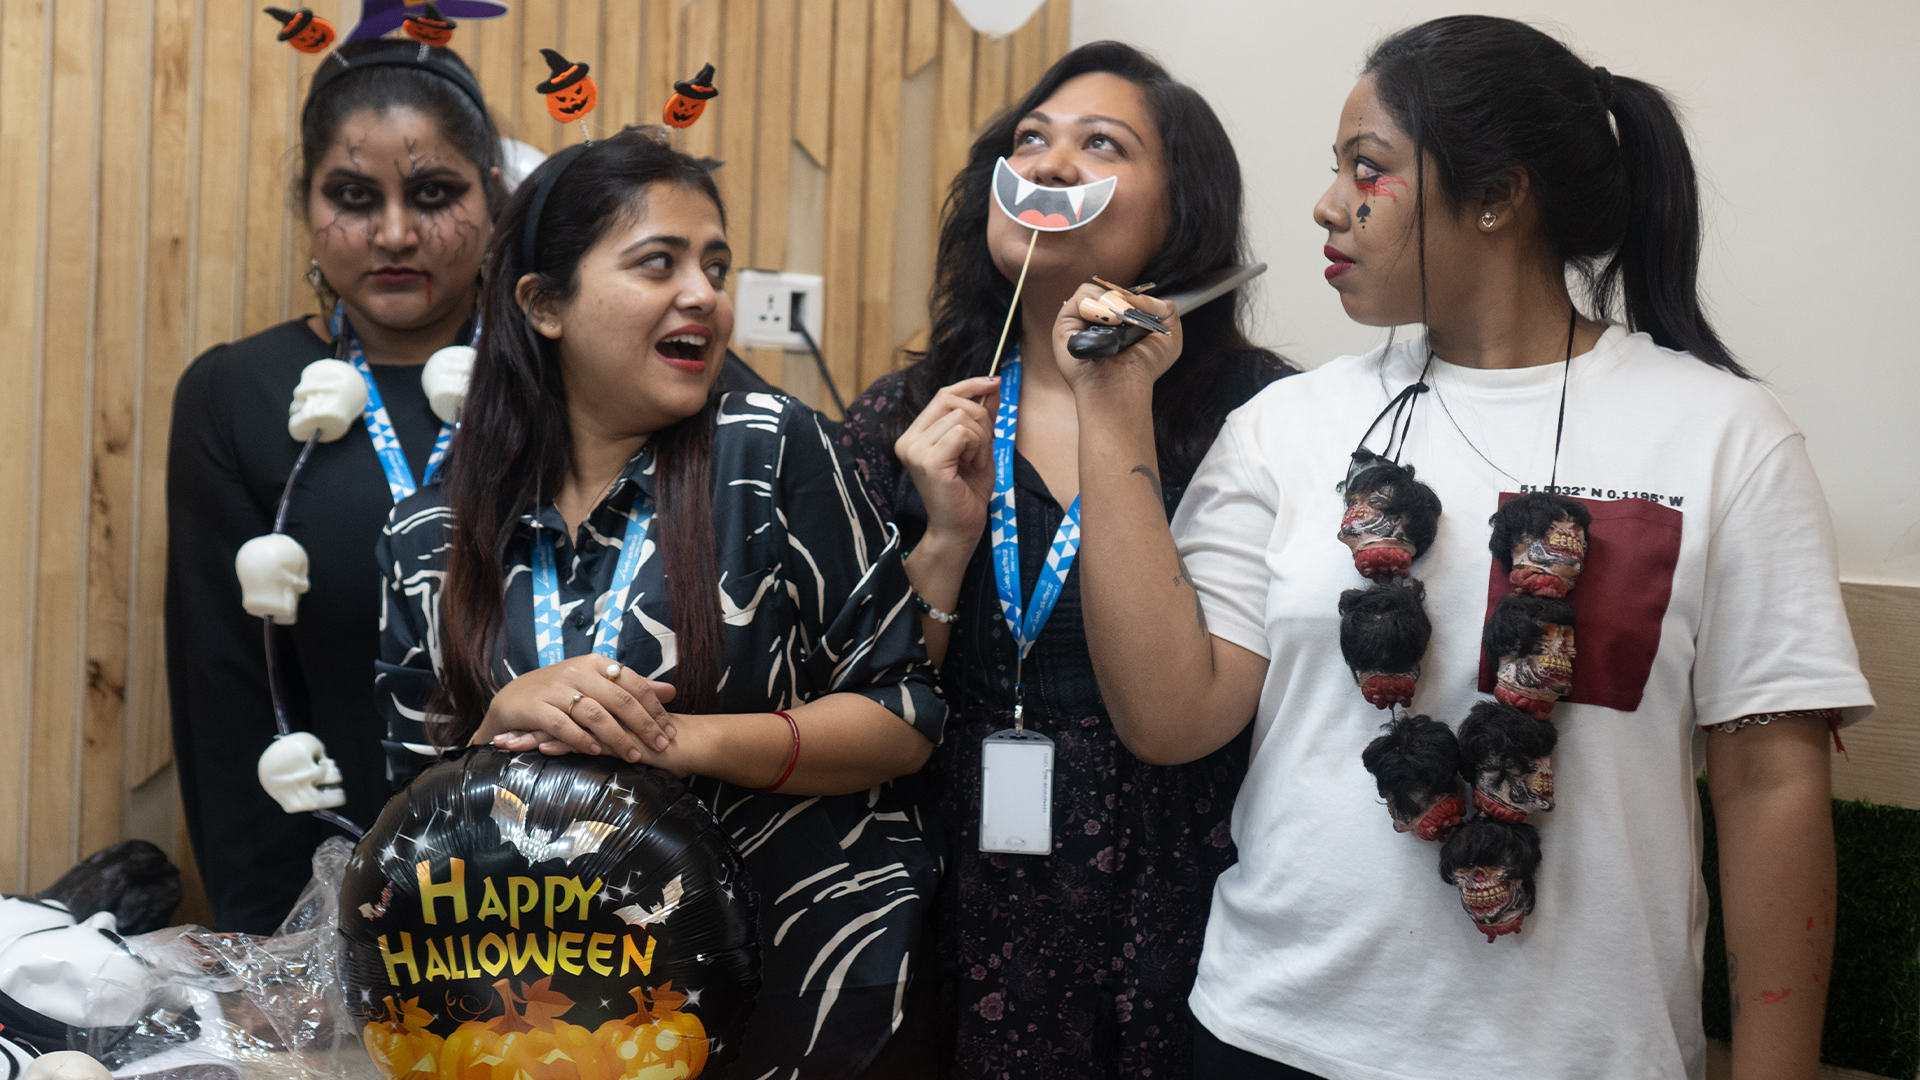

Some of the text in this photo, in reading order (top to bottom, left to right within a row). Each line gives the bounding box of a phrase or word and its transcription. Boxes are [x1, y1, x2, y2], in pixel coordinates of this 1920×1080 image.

[1520, 484, 1684, 507] 515032° N 0.1195° W
[416, 857, 603, 930] HAPPY
[377, 931, 657, 986] HALLOWEEN
